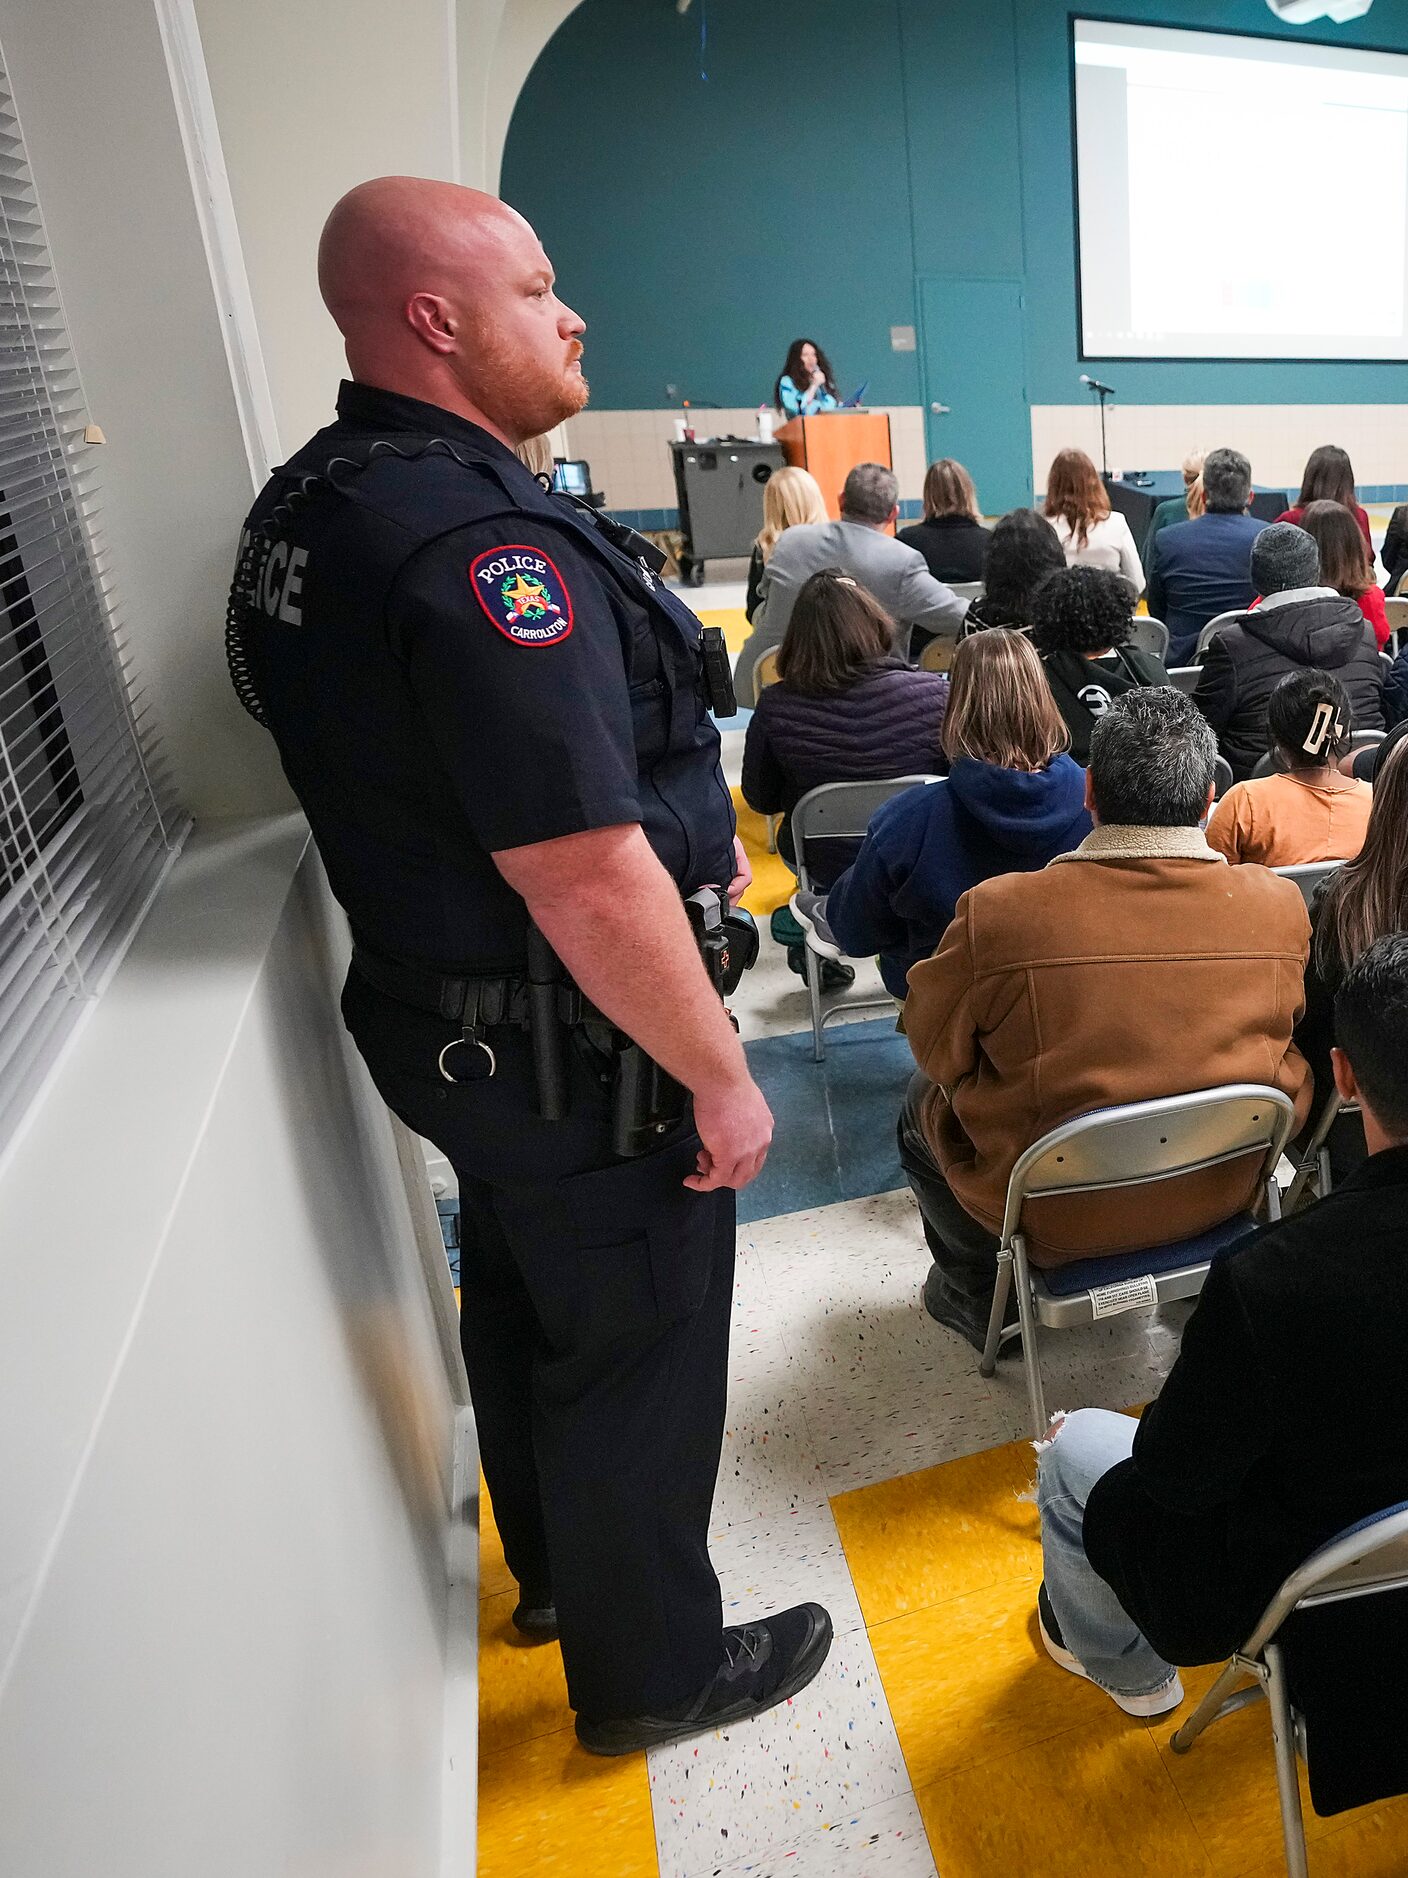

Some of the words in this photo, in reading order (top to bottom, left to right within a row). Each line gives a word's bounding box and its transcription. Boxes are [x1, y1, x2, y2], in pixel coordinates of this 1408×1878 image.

[477, 556, 547, 584] POLICE
[518, 595, 540, 604] TEXAS
[511, 617, 568, 640] CARROLLTON
